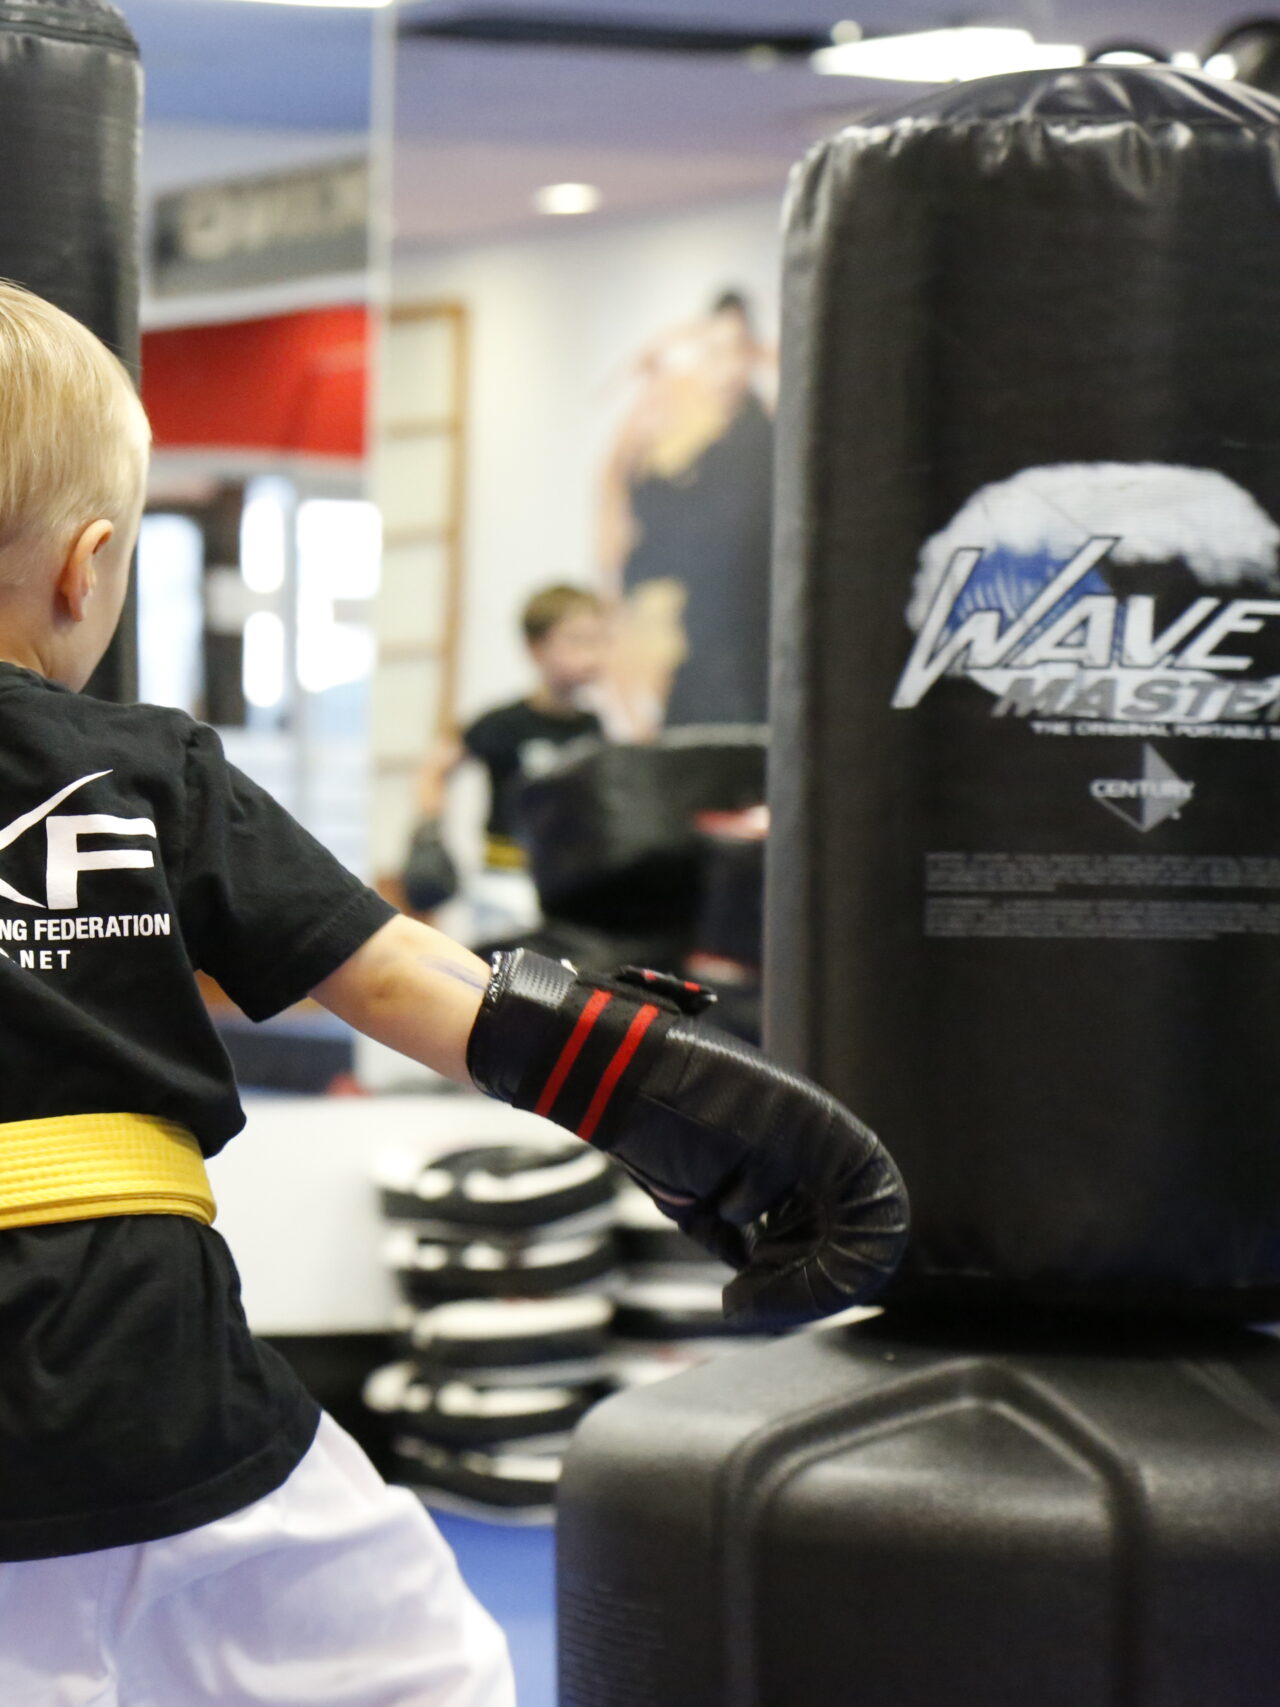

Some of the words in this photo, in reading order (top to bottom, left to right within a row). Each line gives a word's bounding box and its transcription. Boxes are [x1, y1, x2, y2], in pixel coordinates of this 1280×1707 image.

[891, 535, 1280, 708] WAVE
[1088, 778, 1196, 799] CENTURY
[34, 913, 171, 941] FEDERATION
